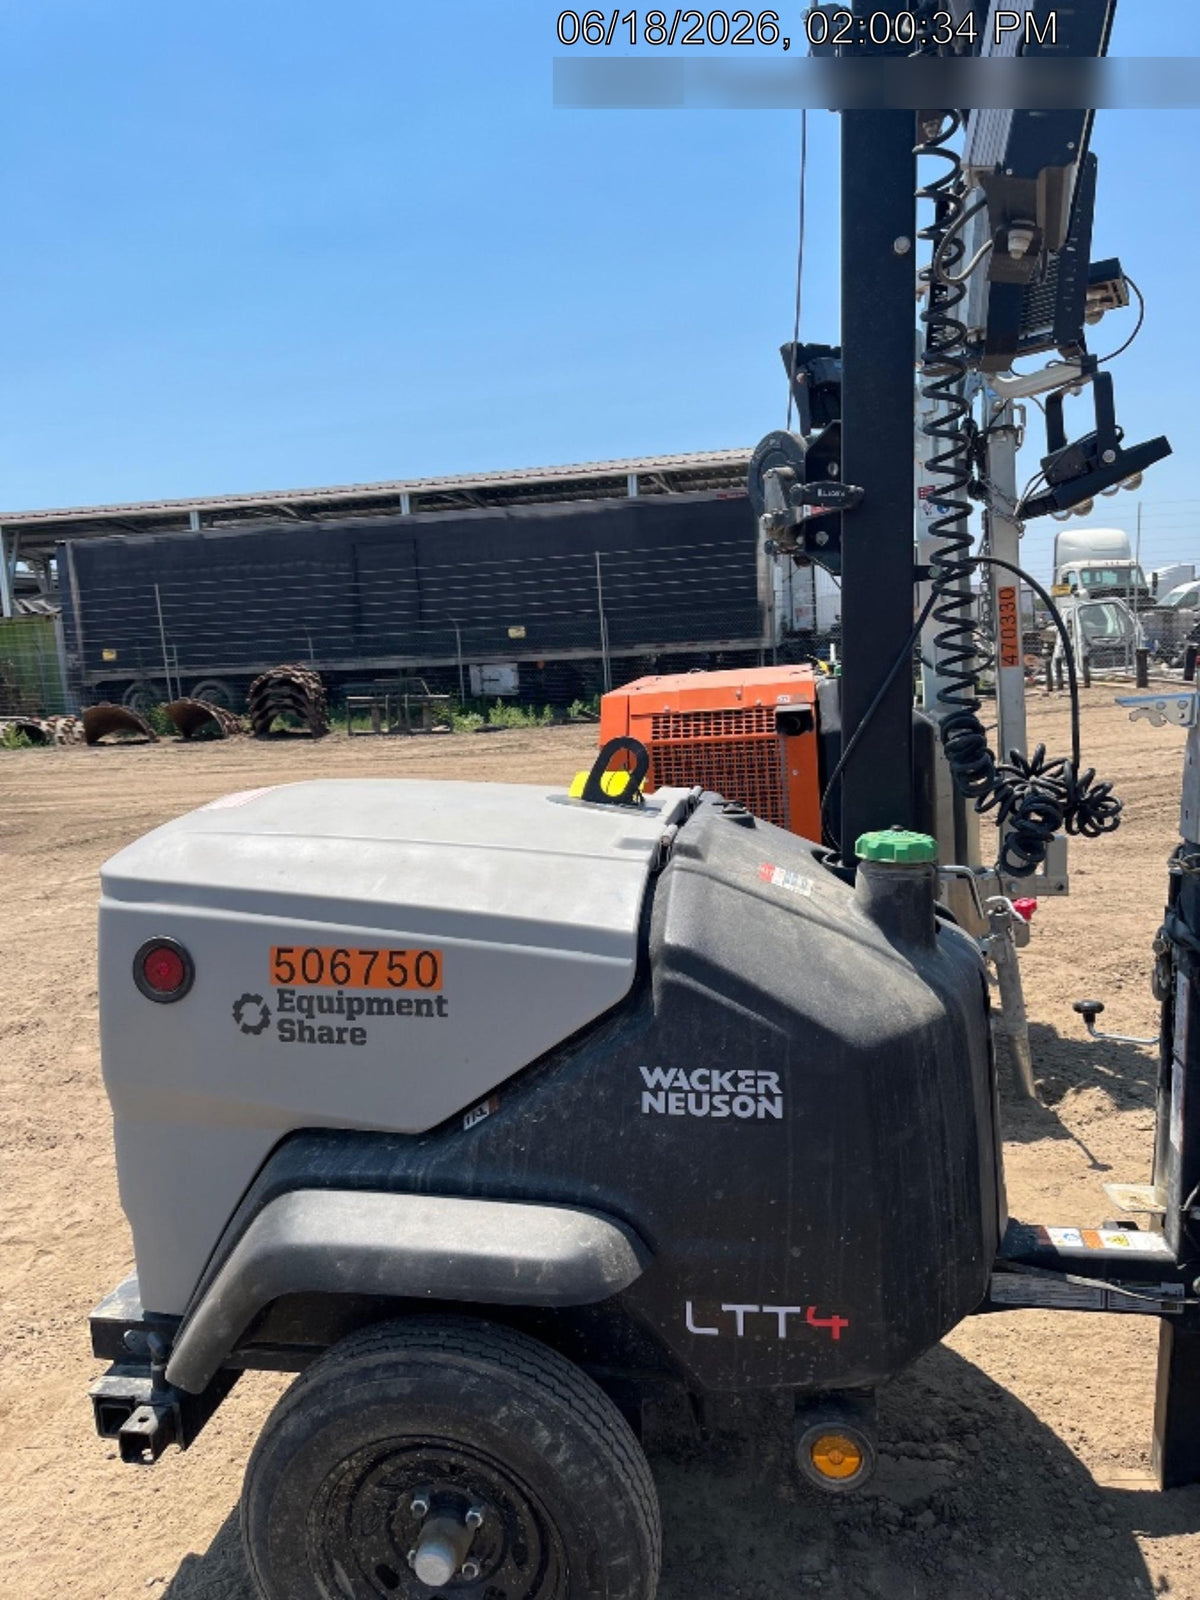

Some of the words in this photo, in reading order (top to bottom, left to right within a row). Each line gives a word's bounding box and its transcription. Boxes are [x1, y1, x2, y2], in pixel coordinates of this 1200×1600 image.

[999, 588, 1017, 664] 470330
[274, 948, 438, 988] 506750
[277, 988, 449, 1020] Equipment
[277, 1018, 367, 1046] Share
[639, 1066, 783, 1094] WACKER
[641, 1091, 784, 1119] NEUSON
[685, 1301, 849, 1340] LTT4
